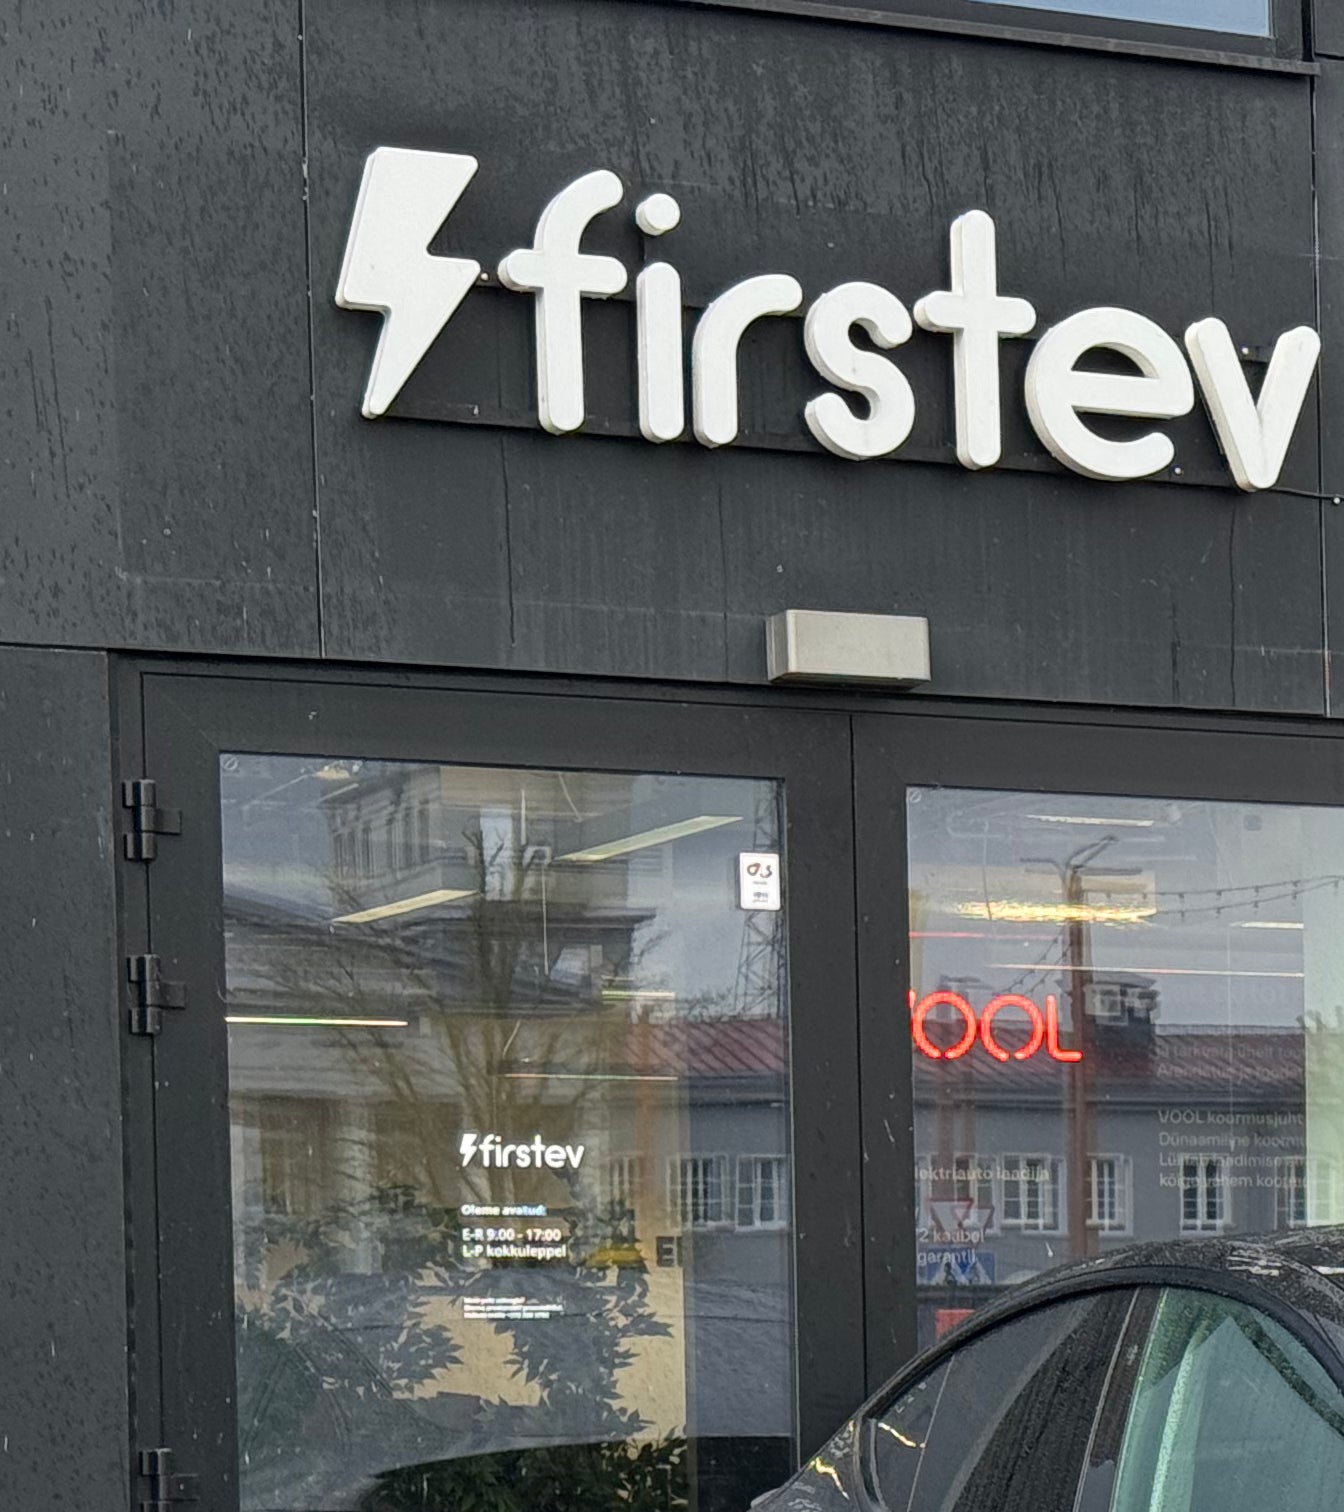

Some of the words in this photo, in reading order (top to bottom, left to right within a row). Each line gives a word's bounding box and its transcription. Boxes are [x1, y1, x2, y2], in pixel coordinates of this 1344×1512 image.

[498, 168, 1322, 492] firstev
[909, 989, 1083, 1063] OOL
[479, 1134, 584, 1168] firstev
[462, 1228, 484, 1241] E-R
[526, 1228, 562, 1241] 17:00
[462, 1244, 484, 1257] L-P
[486, 1244, 567, 1260] kokkuleppel
